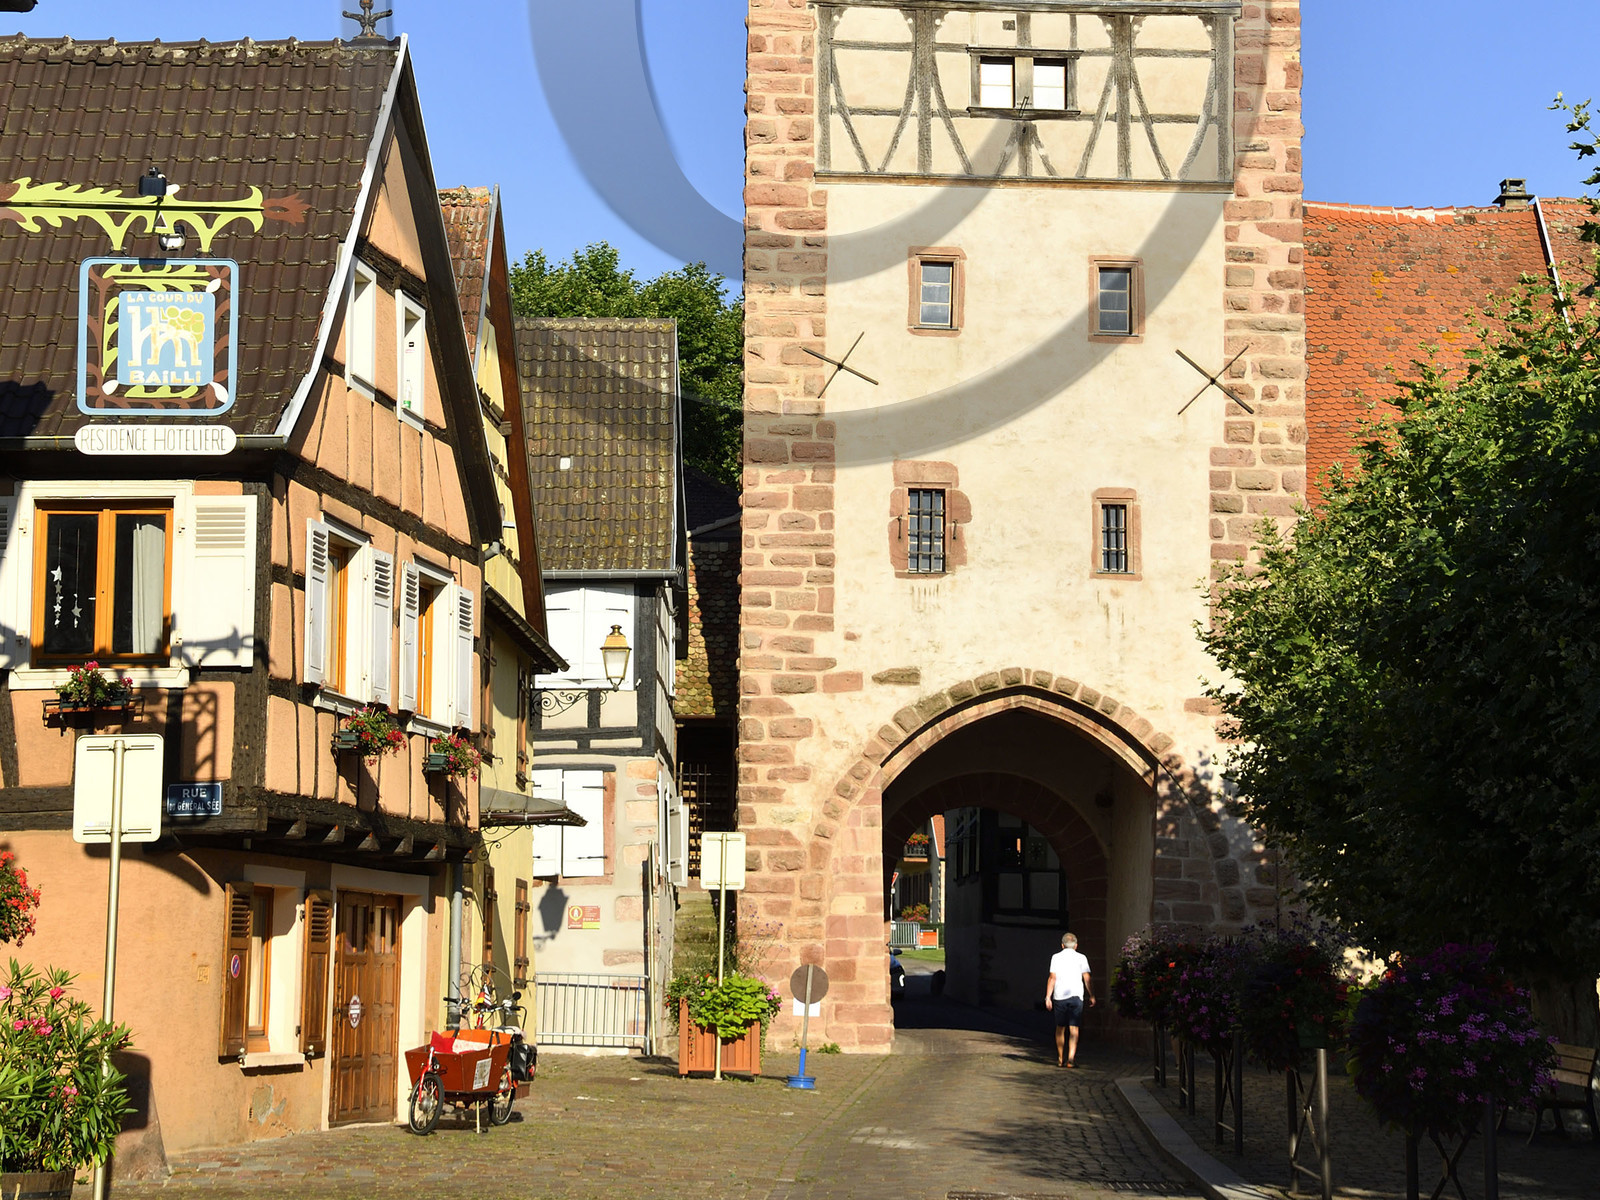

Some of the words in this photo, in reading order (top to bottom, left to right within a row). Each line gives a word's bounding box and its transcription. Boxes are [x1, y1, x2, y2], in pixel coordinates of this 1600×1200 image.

[127, 293, 144, 302] LA
[149, 293, 183, 302] COUR
[187, 293, 203, 303] DU
[80, 428, 147, 451] RESIDENCE
[154, 427, 226, 452] HOTELIERE
[182, 788, 207, 798] RUE
[177, 800, 205, 811] GÉNÉRAL
[207, 798, 220, 811] SÉE
